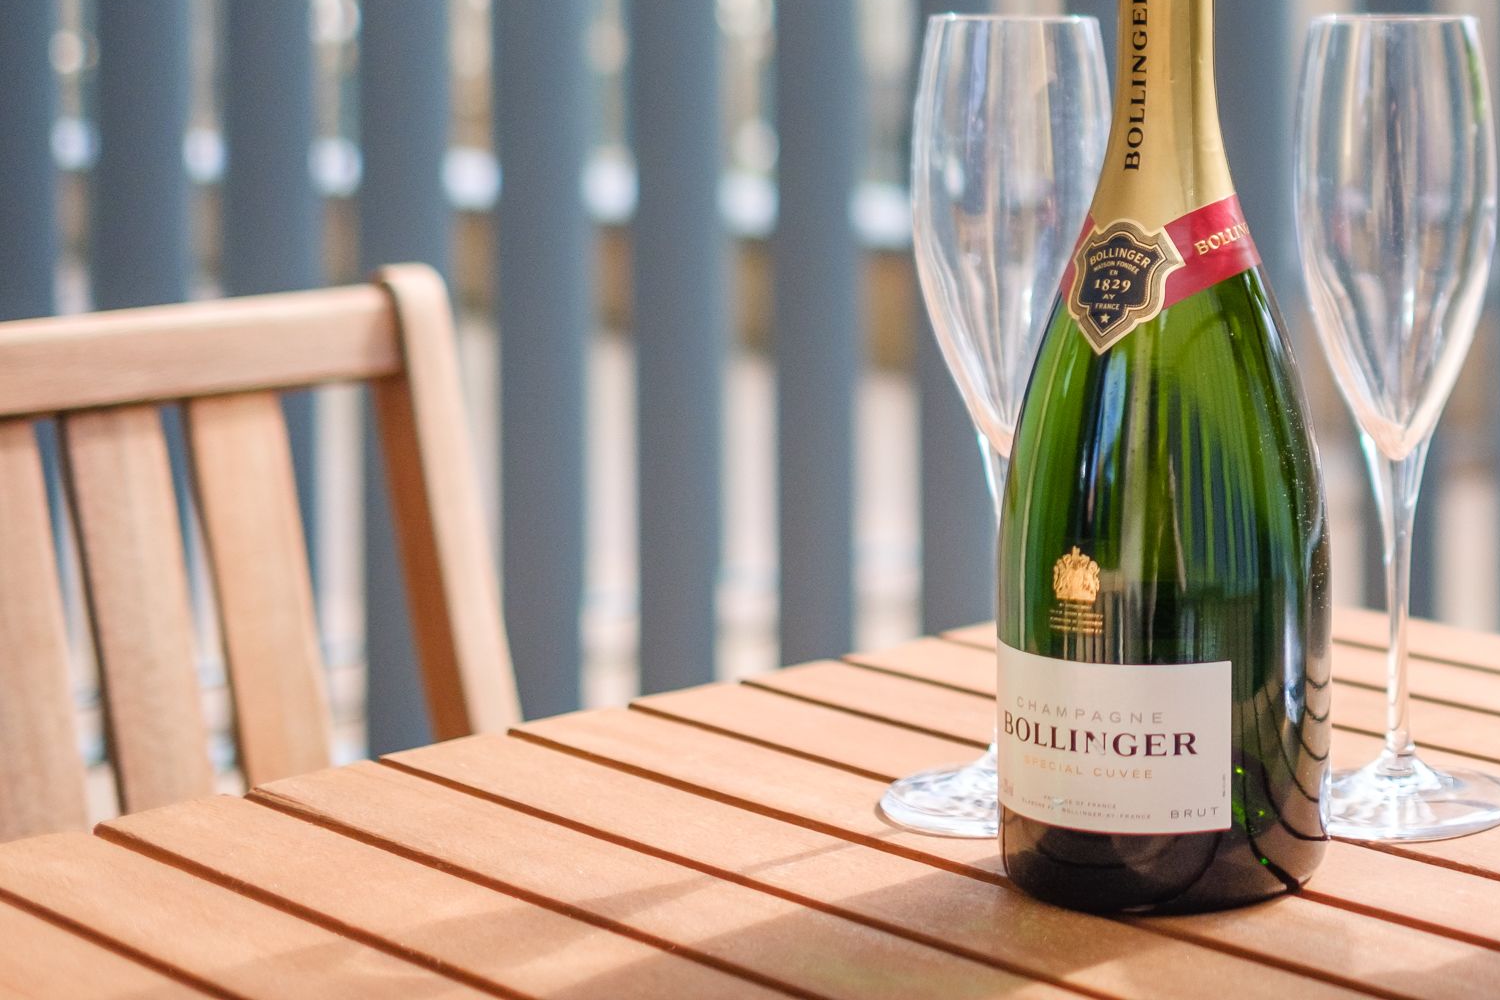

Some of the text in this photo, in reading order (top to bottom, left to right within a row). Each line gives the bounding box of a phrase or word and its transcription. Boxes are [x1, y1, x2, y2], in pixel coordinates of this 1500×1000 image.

[1193, 222, 1250, 256] BOLLIN
[1089, 247, 1151, 268] BOLLINGER
[1094, 278, 1132, 293] 1829
[1094, 302, 1121, 311] FRANCE
[1016, 695, 1164, 724] CHAMPAGNE
[1003, 710, 1198, 757] BOLLINGER
[1023, 754, 1084, 776] SPECIAL
[1170, 805, 1219, 819] BRUT
